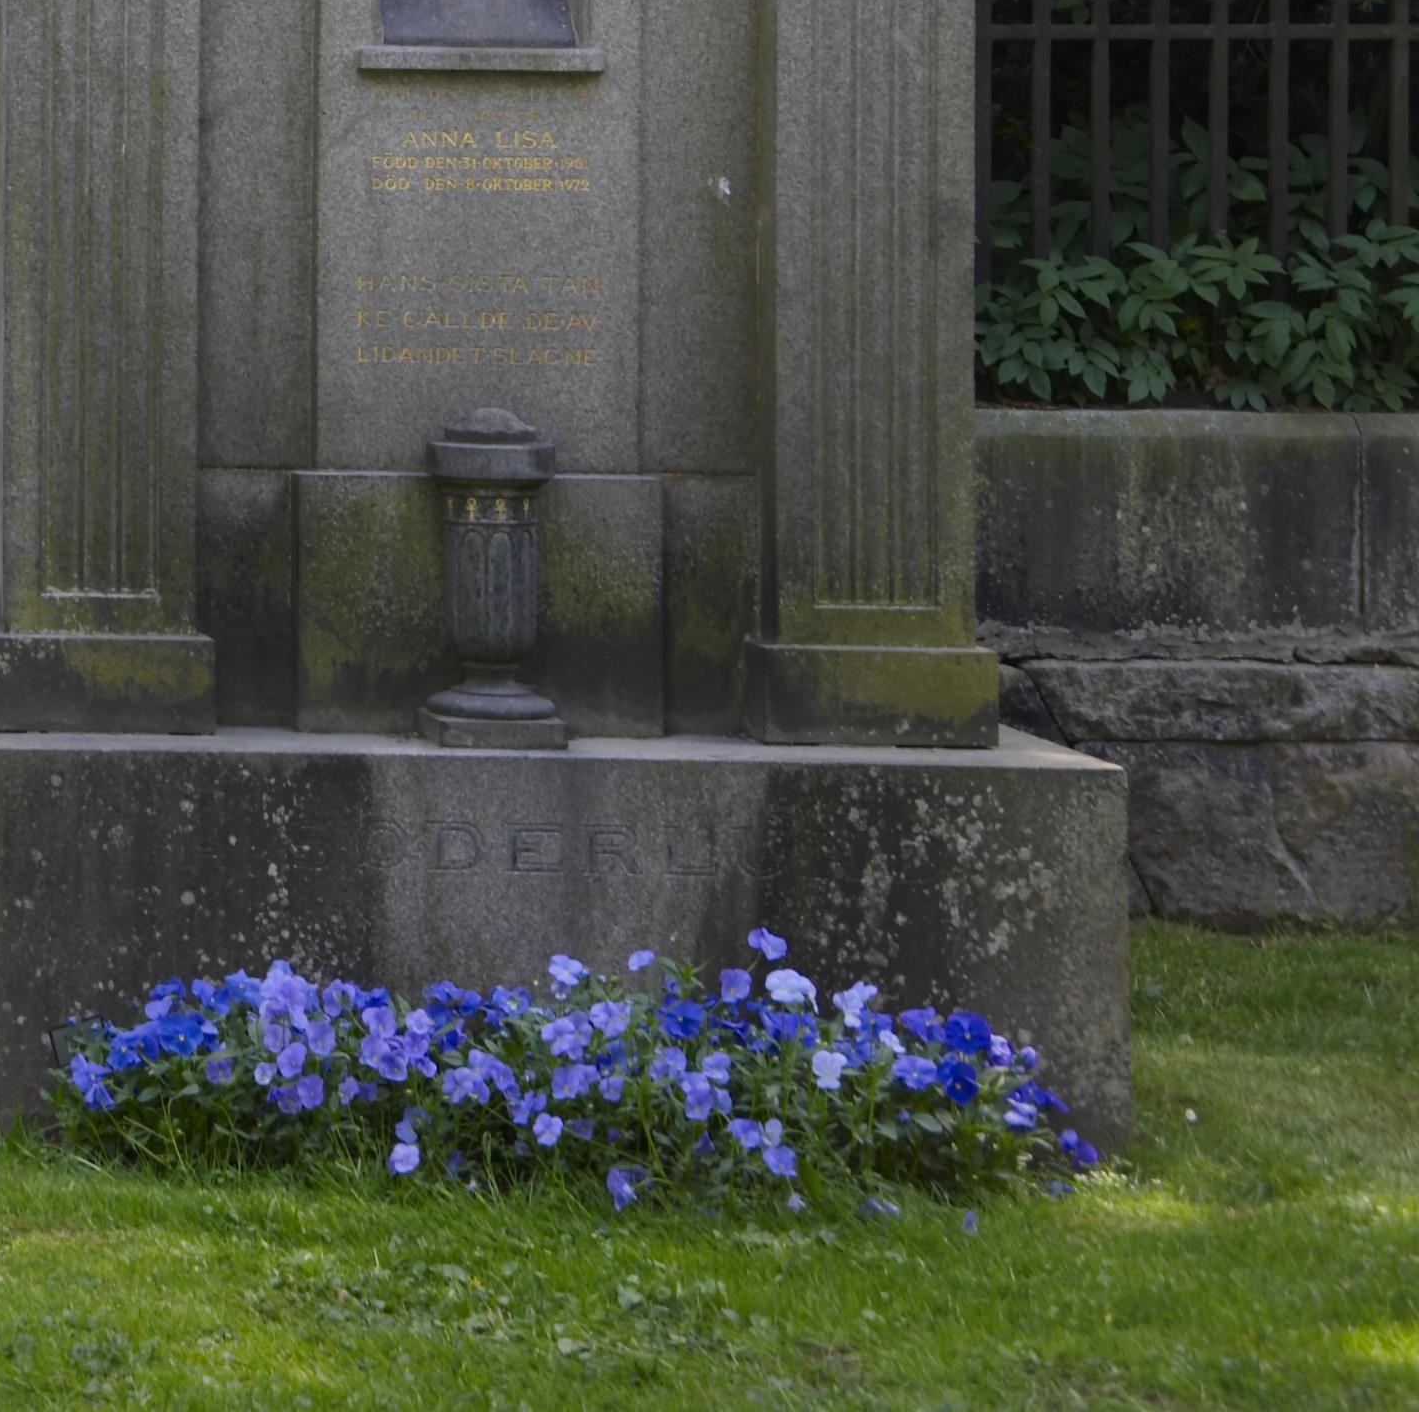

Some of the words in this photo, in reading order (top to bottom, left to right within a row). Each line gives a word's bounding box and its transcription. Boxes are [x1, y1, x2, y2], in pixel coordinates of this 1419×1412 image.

[401, 131, 477, 149] ANNA
[494, 131, 558, 149] LISA
[371, 152, 419, 169] FÖDD
[425, 157, 457, 169] DEN
[483, 156, 553, 170] OKTOBER
[425, 178, 457, 190] DEN
[483, 177, 553, 192] OKTOBER
